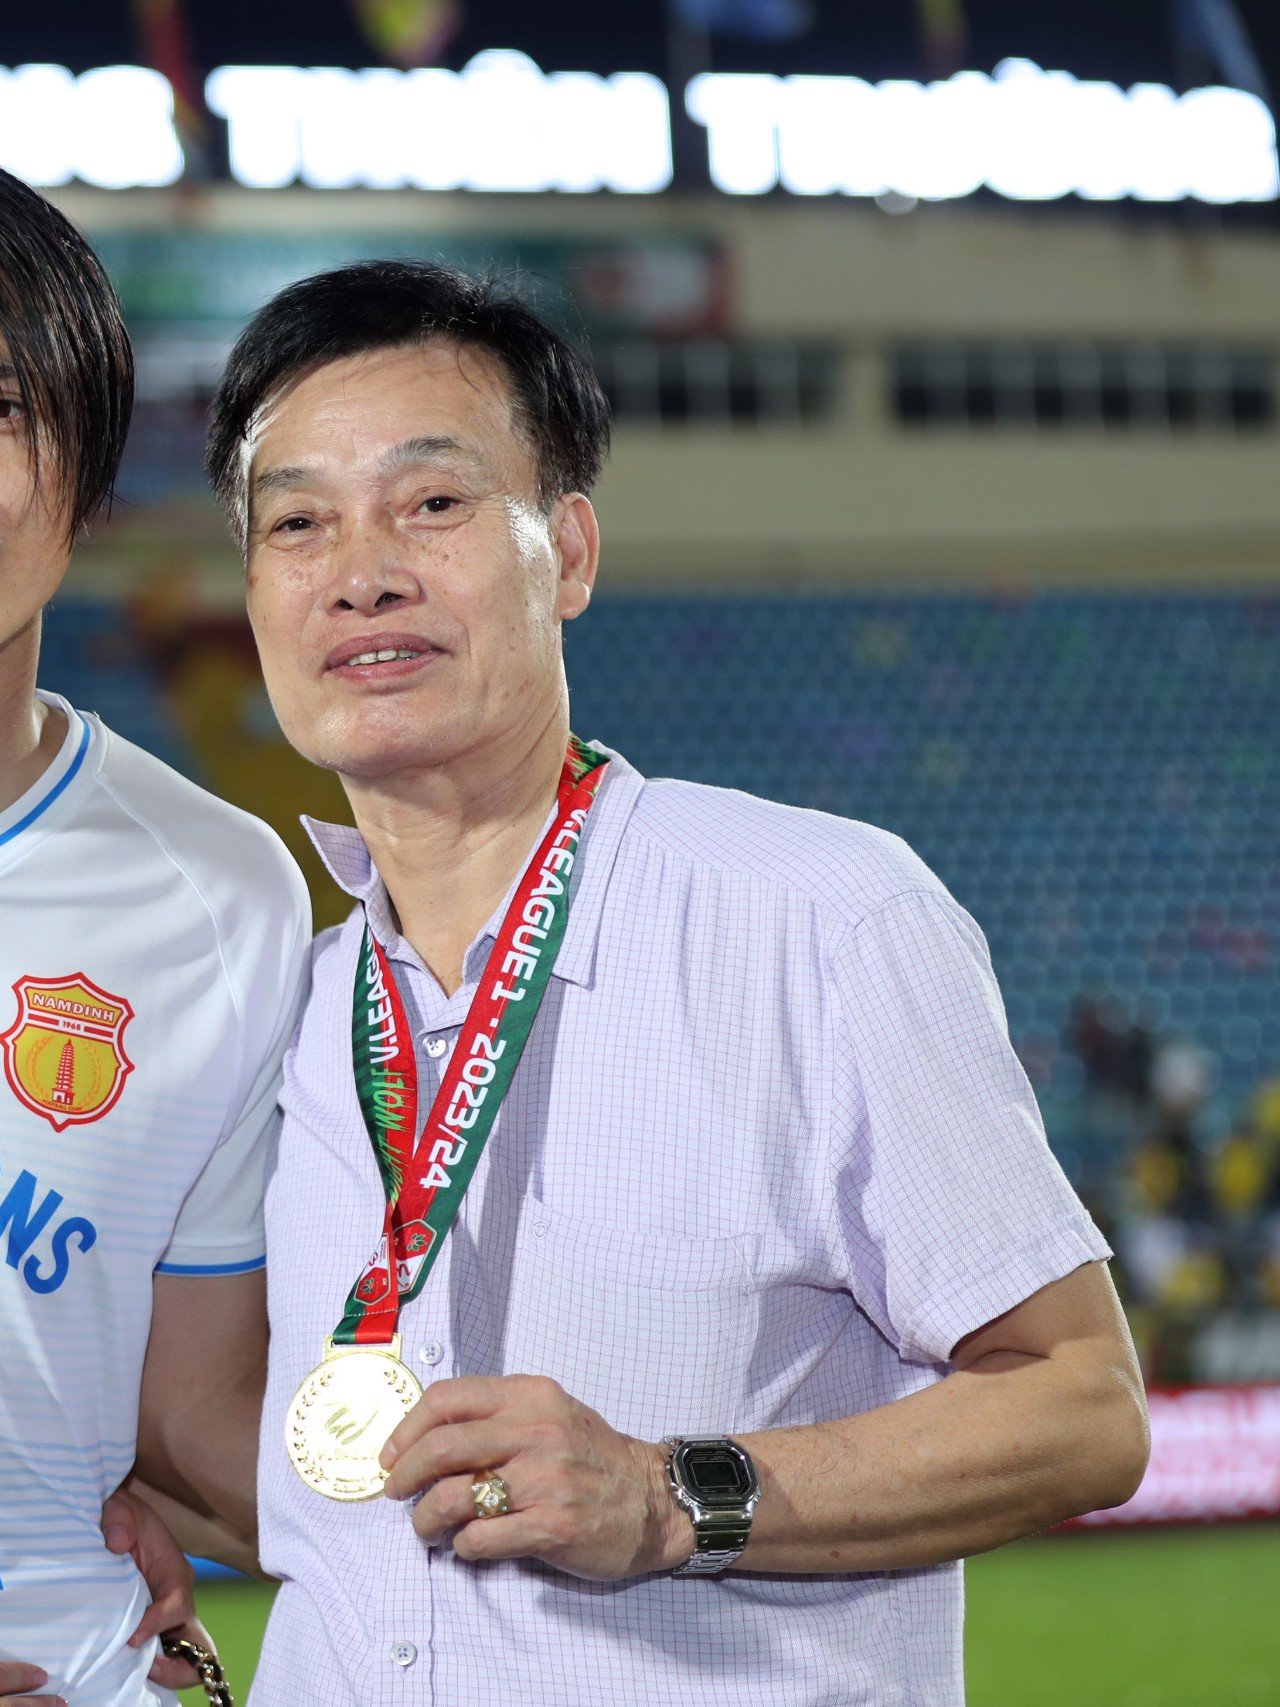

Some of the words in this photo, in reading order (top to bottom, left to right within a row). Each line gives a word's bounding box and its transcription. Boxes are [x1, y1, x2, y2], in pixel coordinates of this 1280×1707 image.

[33, 993, 114, 1022] NAMDINH
[371, 1067, 415, 1133] WOLF
[420, 1031, 507, 1189] 2023/24
